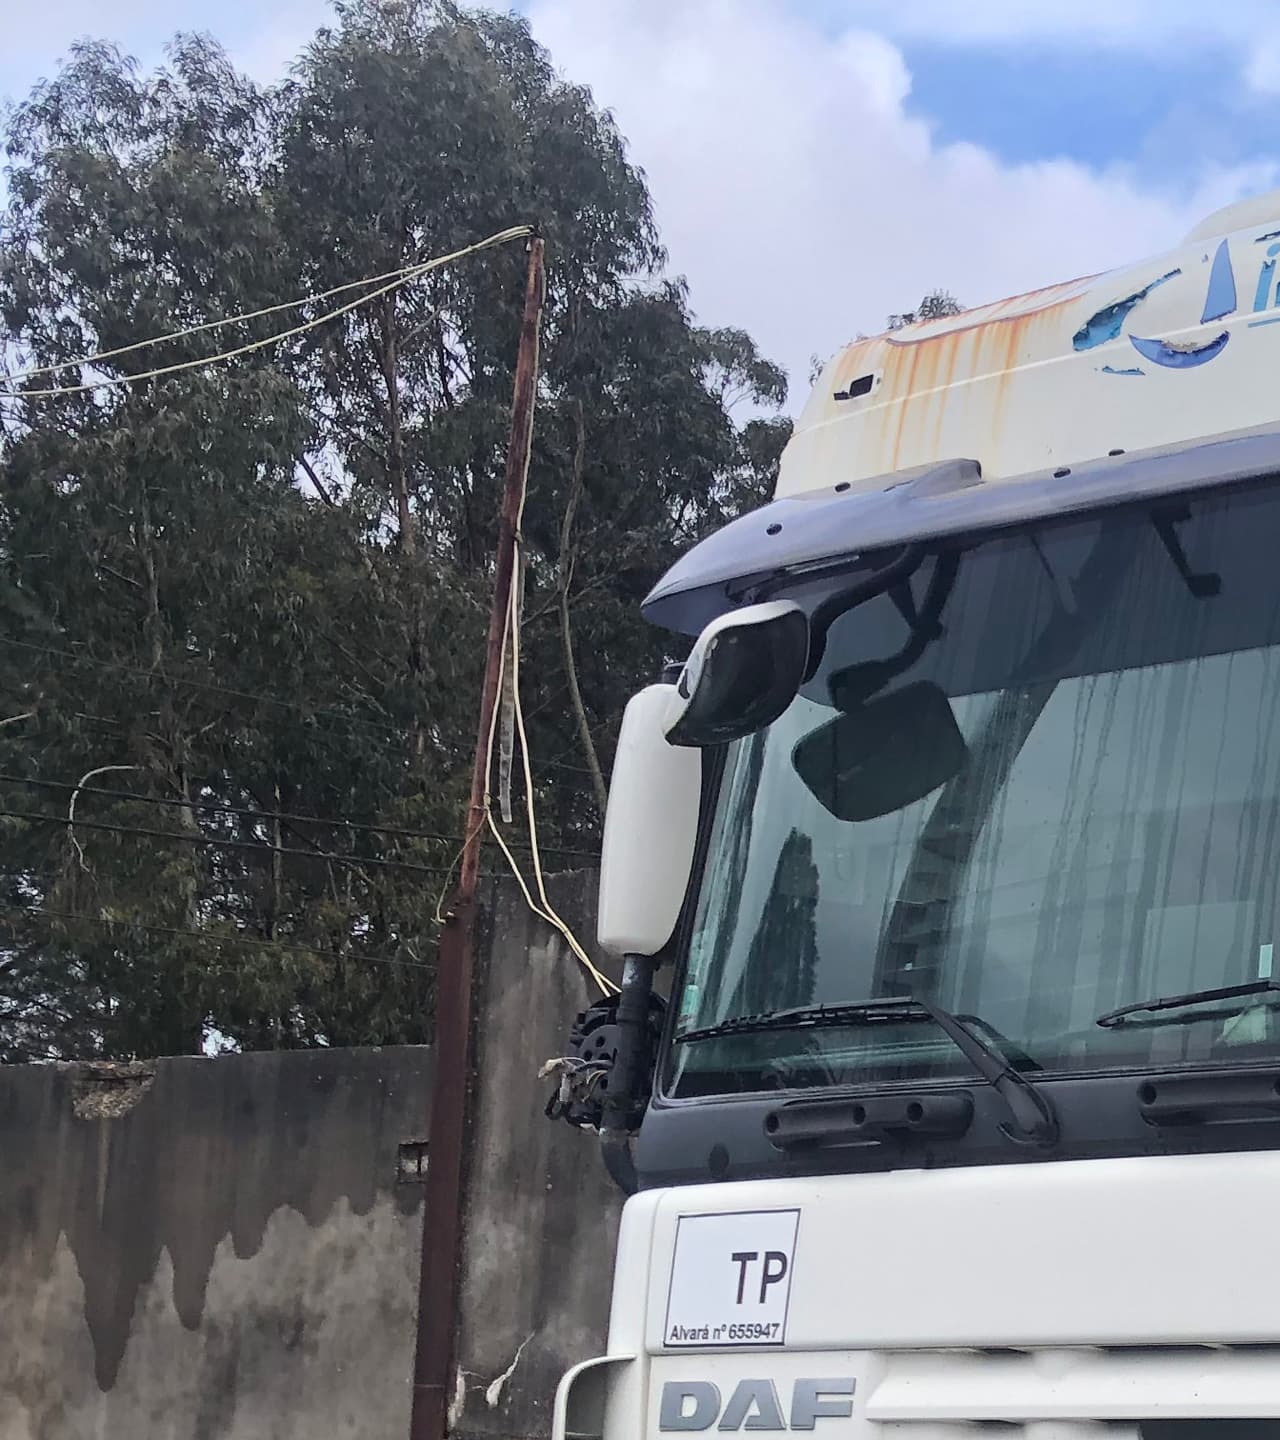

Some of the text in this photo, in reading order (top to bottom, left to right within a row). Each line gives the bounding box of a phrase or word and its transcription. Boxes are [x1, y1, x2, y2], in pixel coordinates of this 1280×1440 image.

[731, 1250, 788, 1304] TP
[670, 1323, 709, 1341] Alvará
[728, 1322, 780, 1340] 655947
[659, 1377, 857, 1432] DAF
